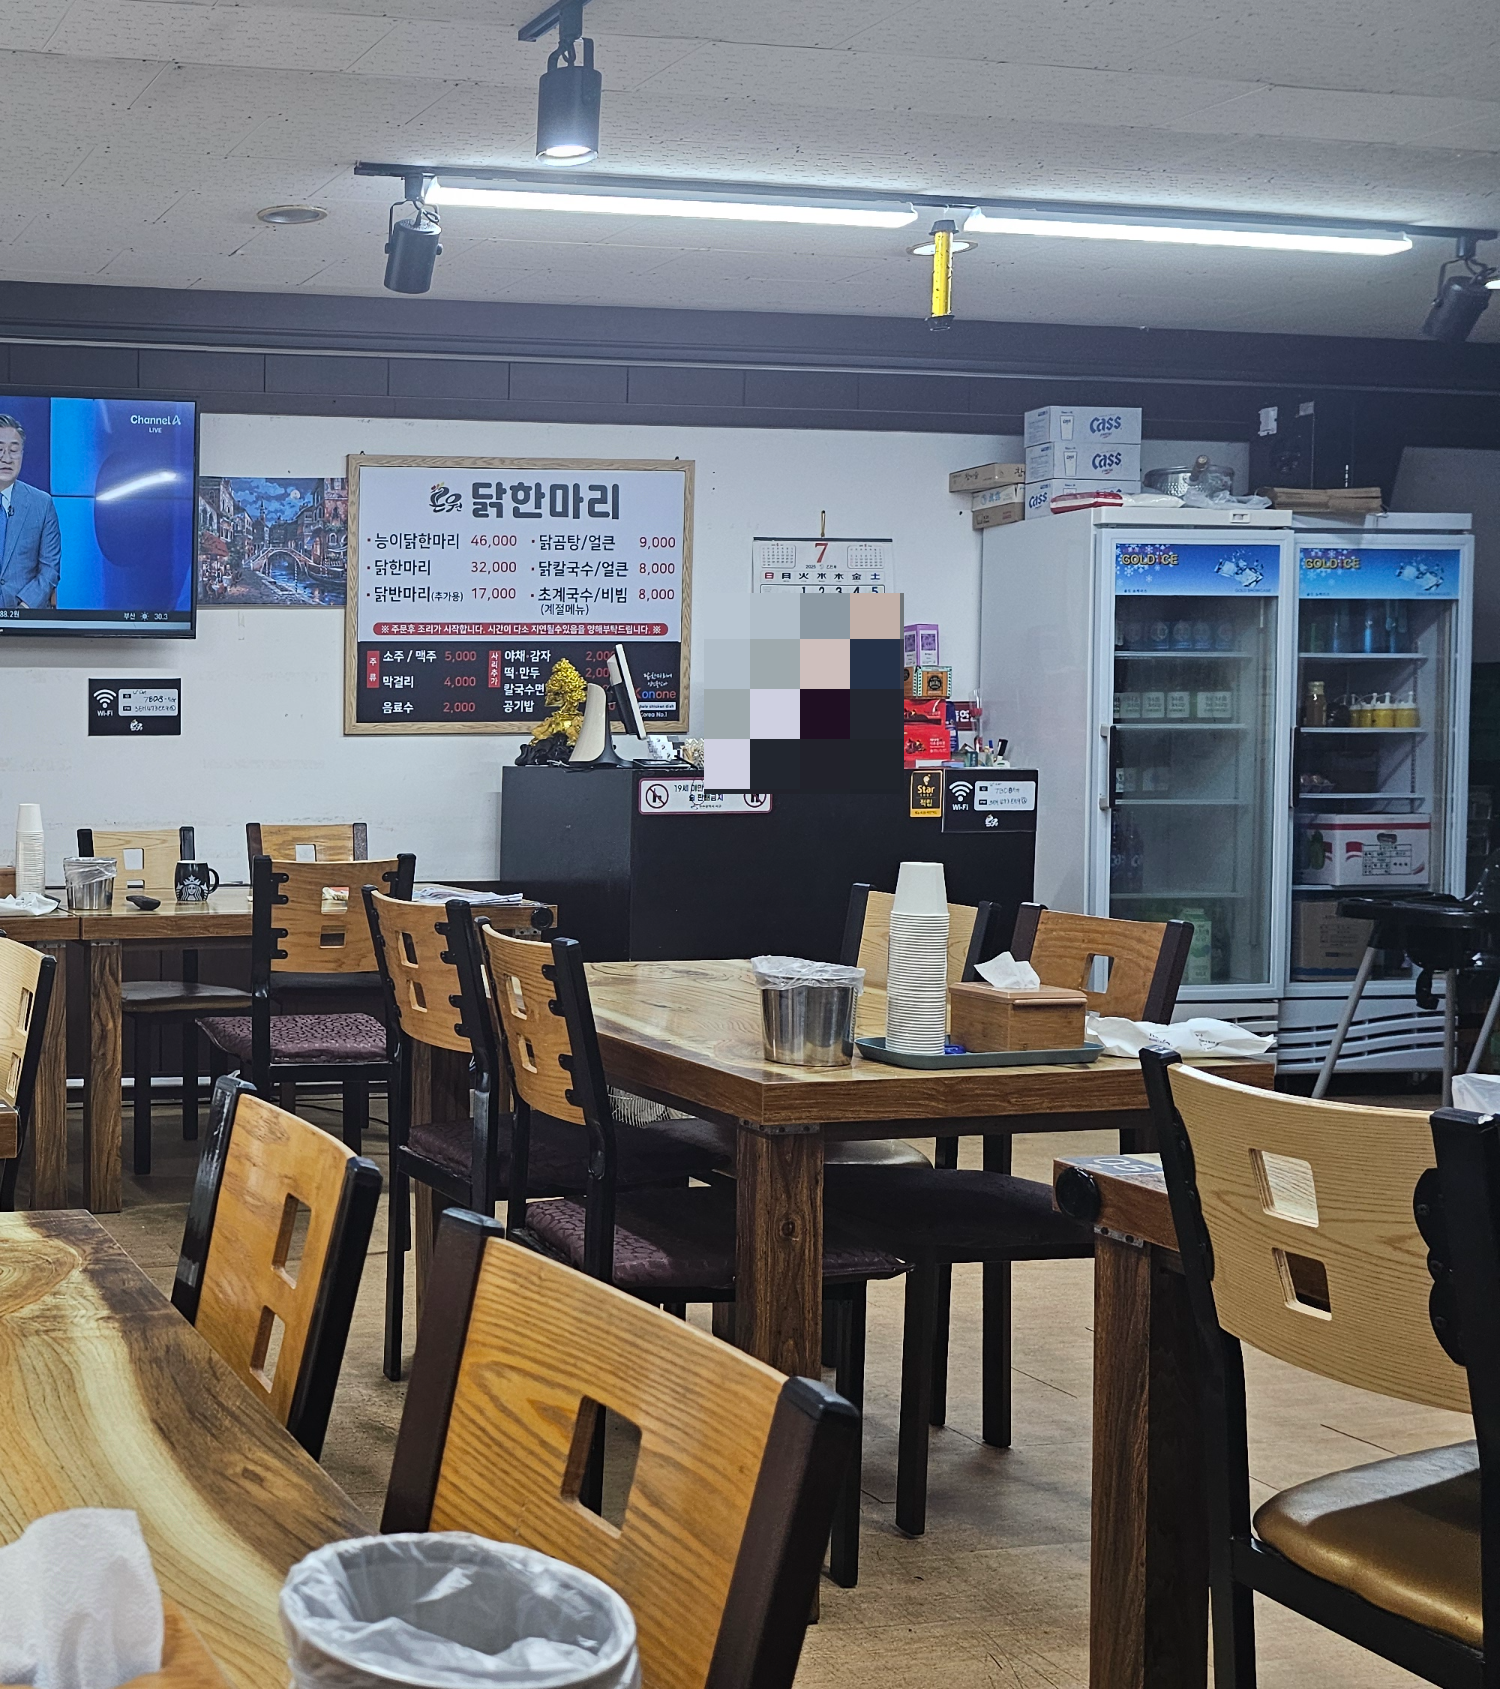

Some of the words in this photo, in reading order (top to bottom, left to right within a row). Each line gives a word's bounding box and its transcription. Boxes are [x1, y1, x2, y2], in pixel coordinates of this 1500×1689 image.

[1090, 416, 1122, 434] Cass
[1092, 452, 1122, 470] Cass
[472, 481, 619, 519] 닭한마리
[1029, 492, 1048, 508] Cass
[375, 533, 459, 550] 능이닭한마리
[471, 535, 517, 548] 46,000
[539, 534, 616, 551] 닭곰탕/얼큰
[639, 536, 676, 550] 9,000
[815, 542, 828, 563] 7
[1121, 554, 1155, 565] GOLD
[375, 559, 431, 576] 닭한마리
[471, 561, 517, 575] 32,000
[539, 561, 629, 577] 닭칼국수/얼큰
[639, 563, 675, 576] 8,000
[1305, 558, 1338, 569] GOLD
[471, 588, 516, 601] 17,000
[538, 587, 627, 604] 초계국수/비빔
[638, 588, 675, 602] 8,000
[540, 603, 589, 615] (계절메뉴)
[391, 624, 416, 634] 주문후
[417, 624, 441, 634] 조리가
[443, 624, 486, 635] 시작합니다.
[487, 624, 512, 635] 시간이
[513, 624, 530, 635] 다소
[382, 650, 405, 662] 소주
[415, 650, 437, 663] 맥주
[445, 651, 477, 662] 5,000
[490, 652, 499, 686] 사리추가
[382, 675, 414, 689] 막걸리
[444, 676, 476, 688] 4,000
[382, 701, 414, 714] 음료수
[443, 702, 476, 713] 2,000
[503, 700, 534, 713] 공기밥
[917, 785, 935, 794] Star
